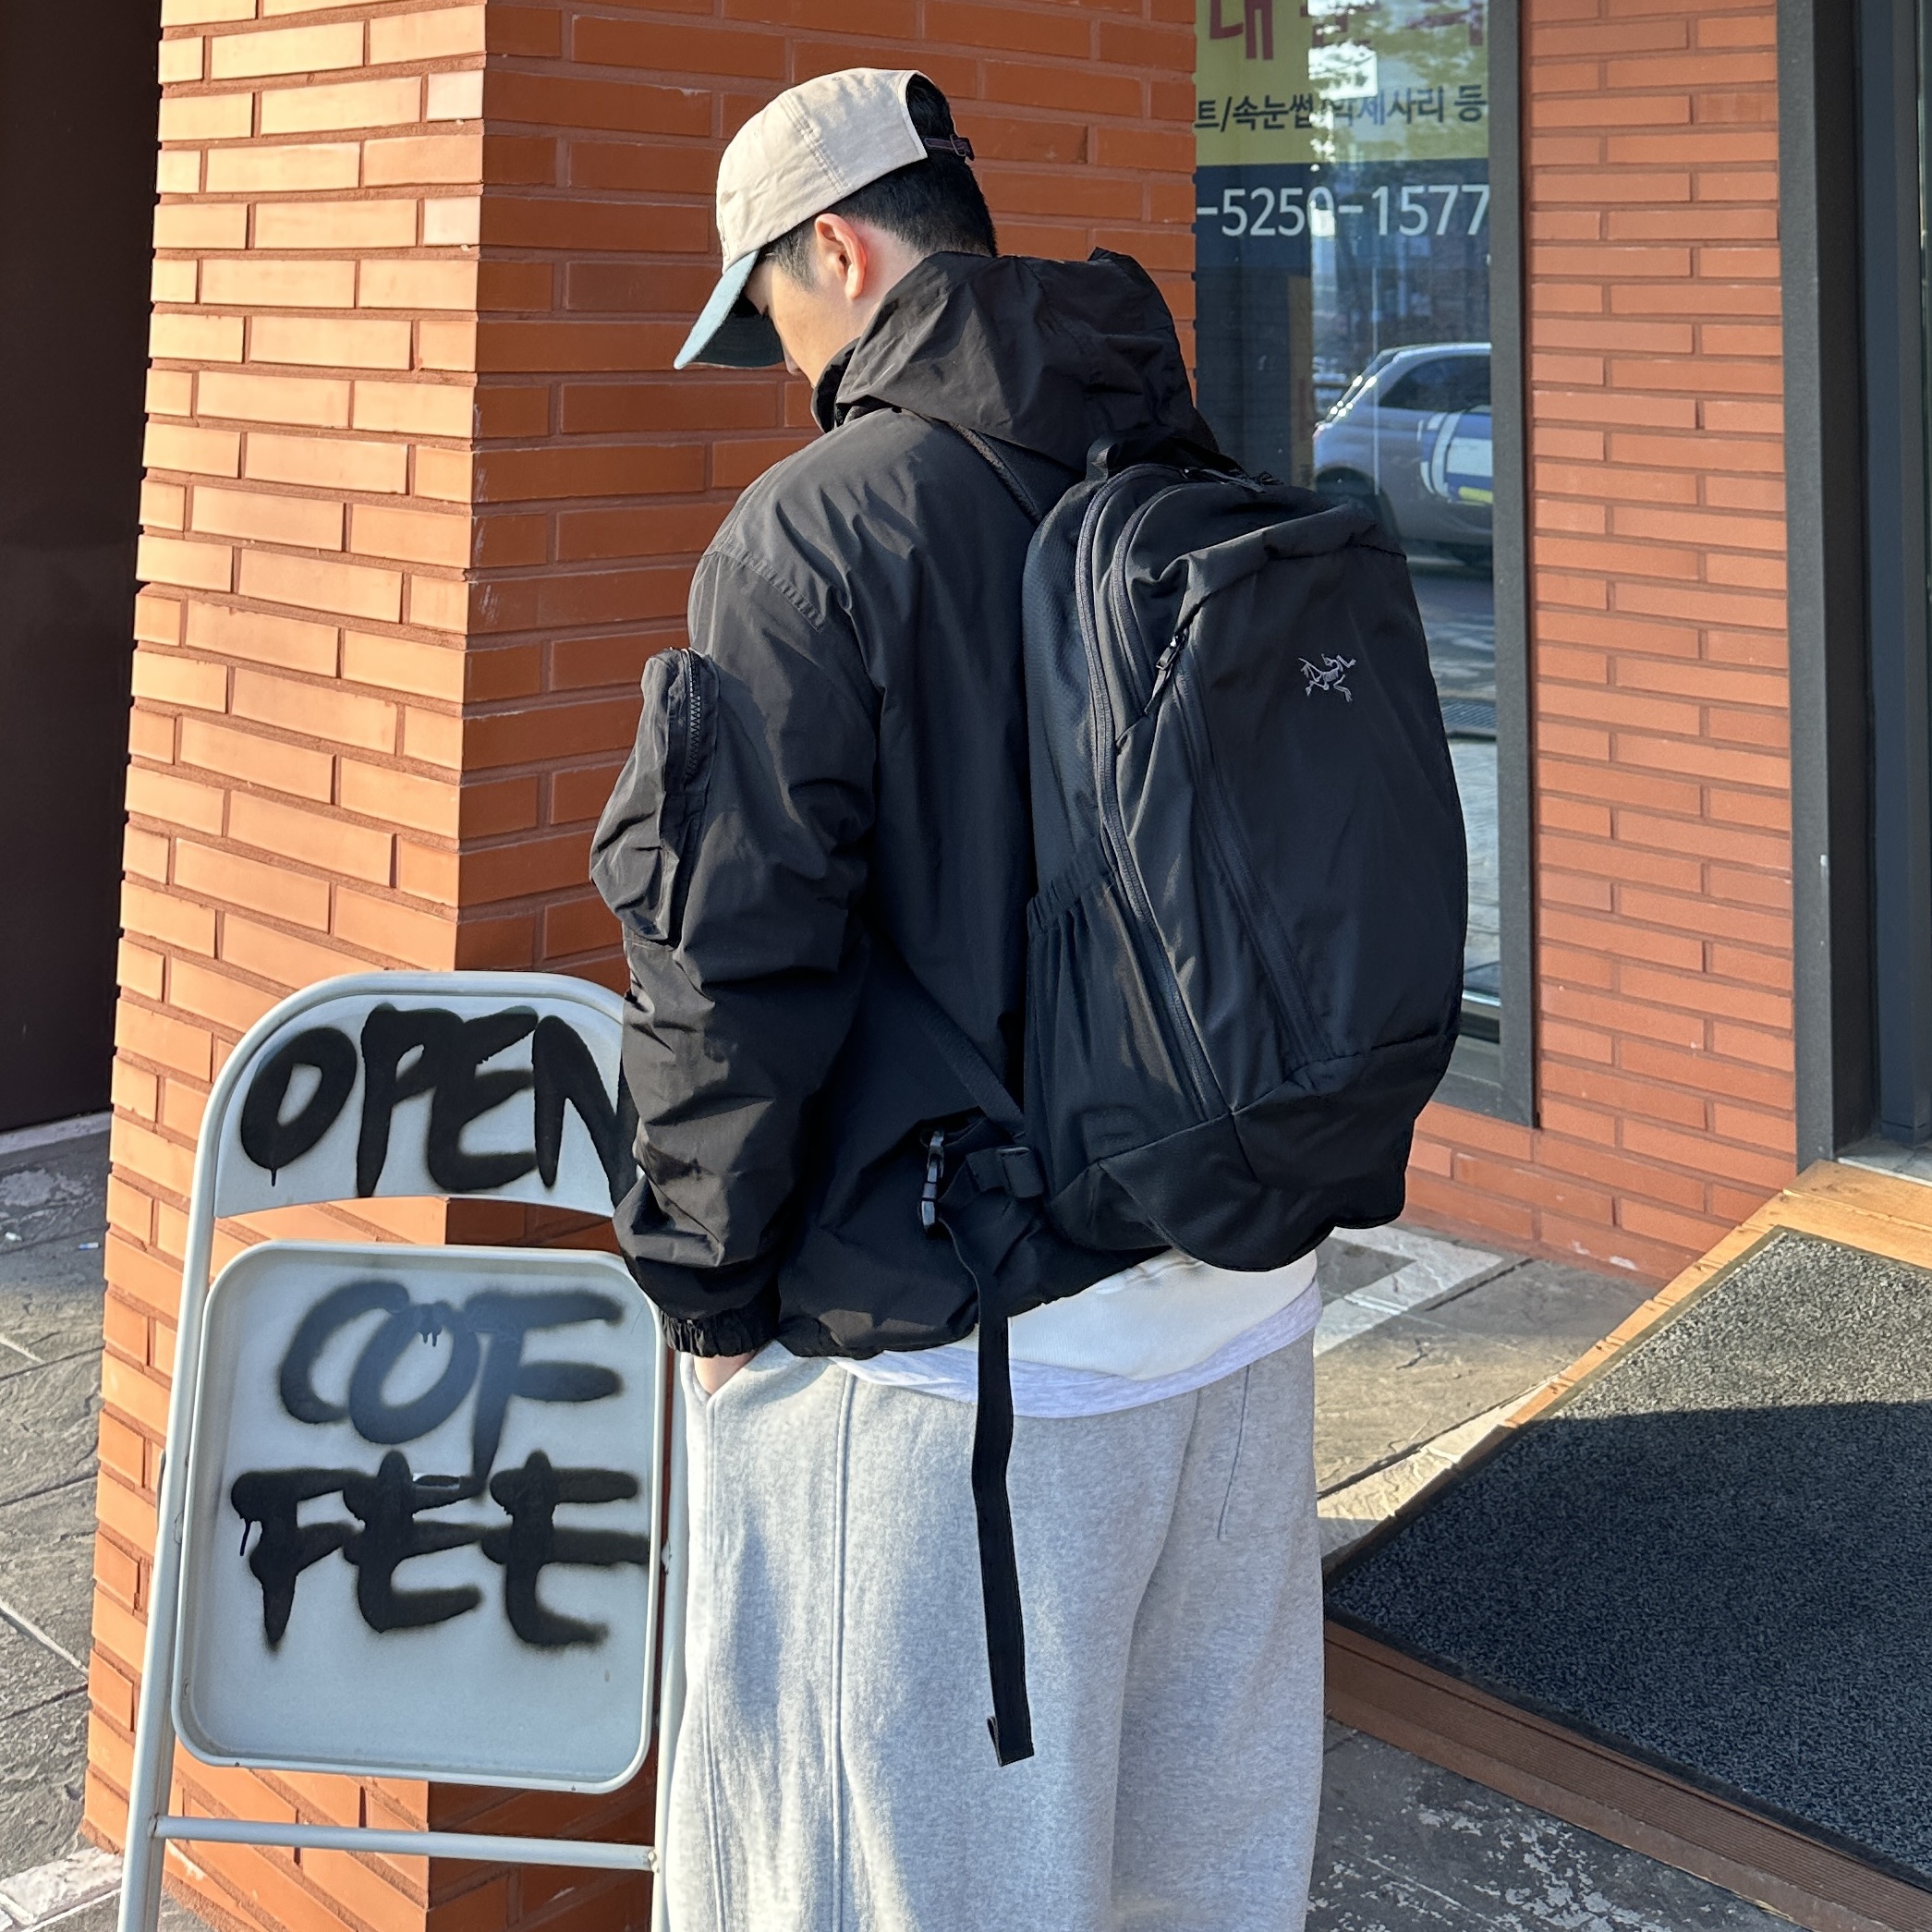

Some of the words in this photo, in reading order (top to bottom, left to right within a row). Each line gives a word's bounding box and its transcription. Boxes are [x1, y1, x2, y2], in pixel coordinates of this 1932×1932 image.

[1453, 84, 1487, 122] 등
[240, 1002, 638, 1208] OPEN
[280, 1280, 623, 1496] COF
[230, 1450, 650, 1651] FEE
